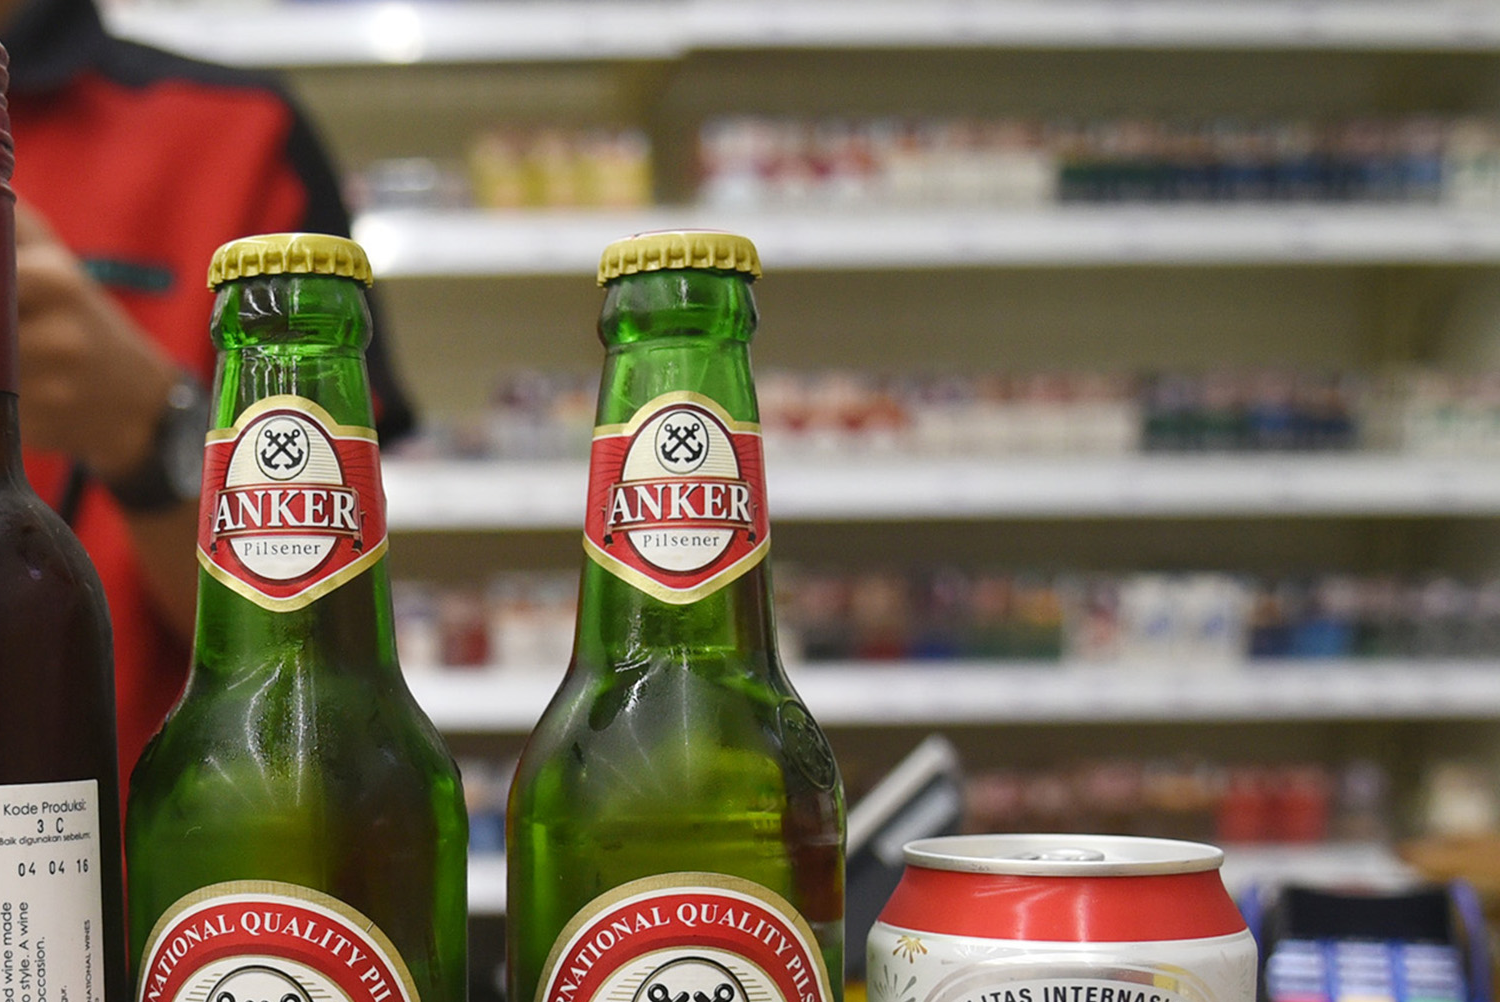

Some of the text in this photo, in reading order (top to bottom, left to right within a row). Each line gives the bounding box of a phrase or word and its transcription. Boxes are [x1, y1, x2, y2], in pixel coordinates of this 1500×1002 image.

[213, 489, 358, 532] ANKER
[608, 483, 752, 524] ANKER
[244, 542, 321, 556] Pilsener
[643, 533, 720, 548] Pilsener
[4, 802, 38, 816] Kode
[36, 817, 64, 834] 3 C
[19, 835, 62, 846] digunakan
[18, 858, 89, 877] 04 04 16
[0, 902, 12, 946] made
[17, 902, 29, 936] wine
[676, 902, 792, 958] QUALITY
[18, 940, 30, 951] A
[240, 910, 368, 970] QUALITY
[2, 950, 14, 984] wine
[18, 954, 32, 990] style.
